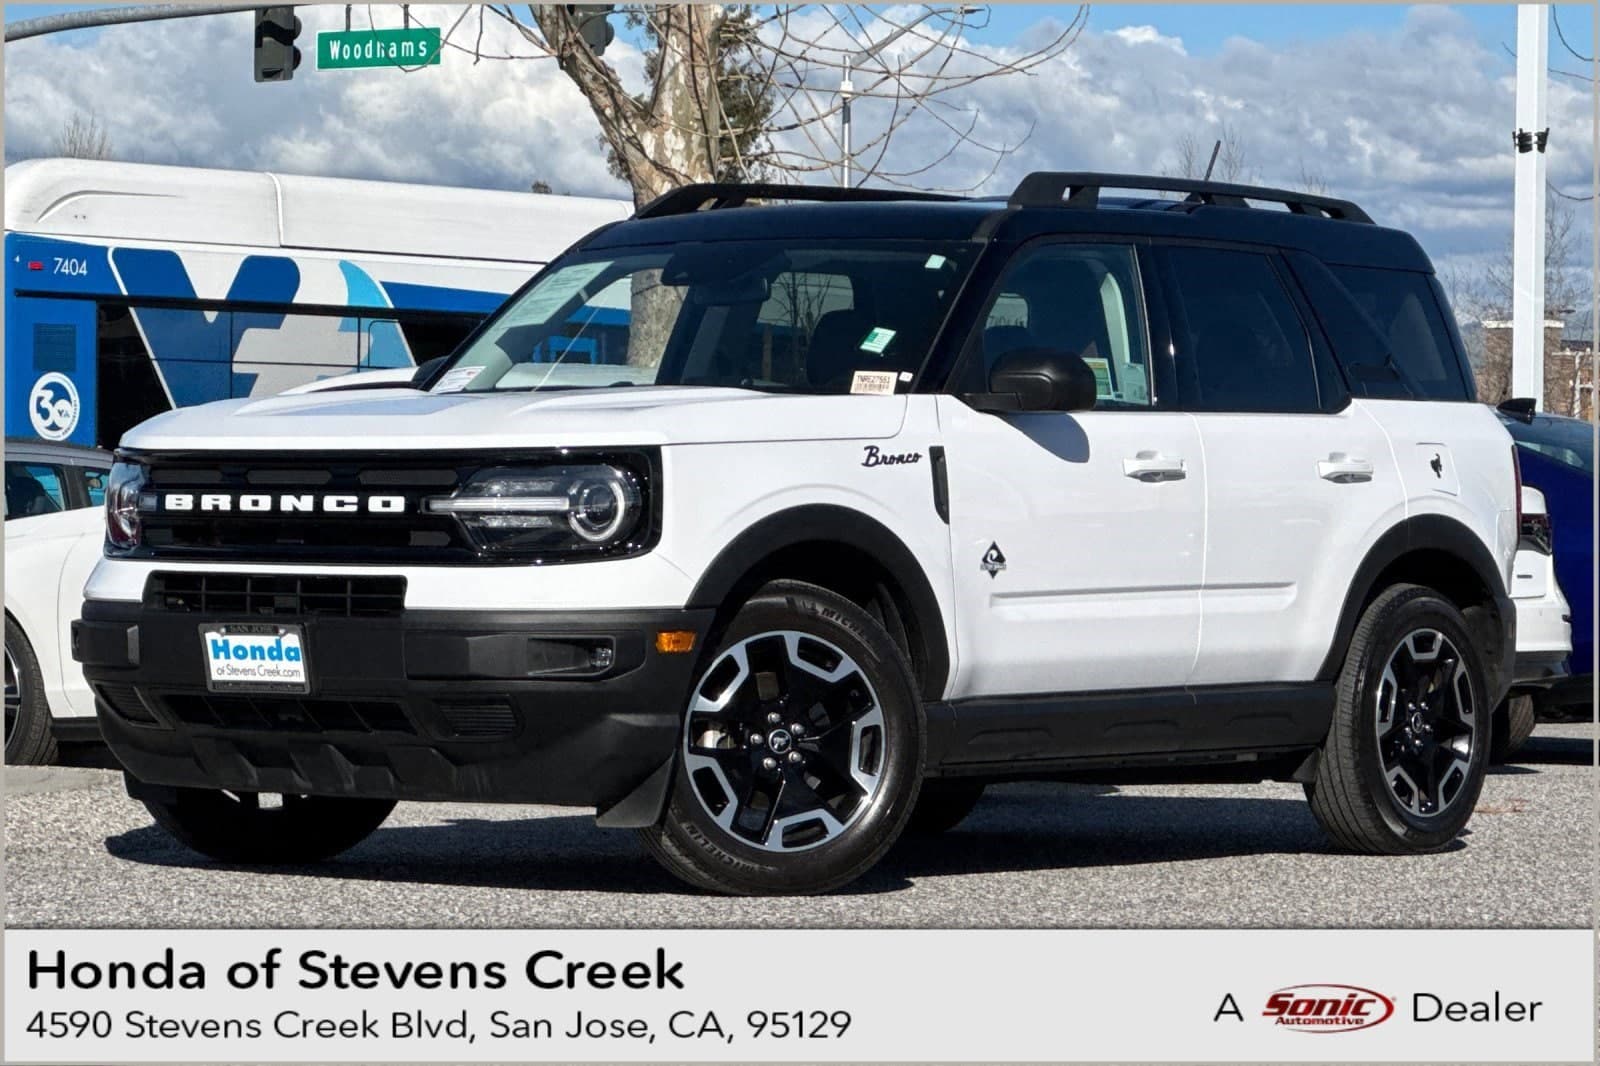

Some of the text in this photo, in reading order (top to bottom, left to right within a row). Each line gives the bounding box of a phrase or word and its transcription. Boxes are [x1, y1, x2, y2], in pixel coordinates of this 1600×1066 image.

[329, 39, 428, 60] Woodhams
[53, 257, 88, 275] 7404
[861, 445, 922, 467] Bronco
[165, 494, 405, 512] BRONCO
[211, 638, 301, 662] Honda
[226, 663, 257, 676] Stevens
